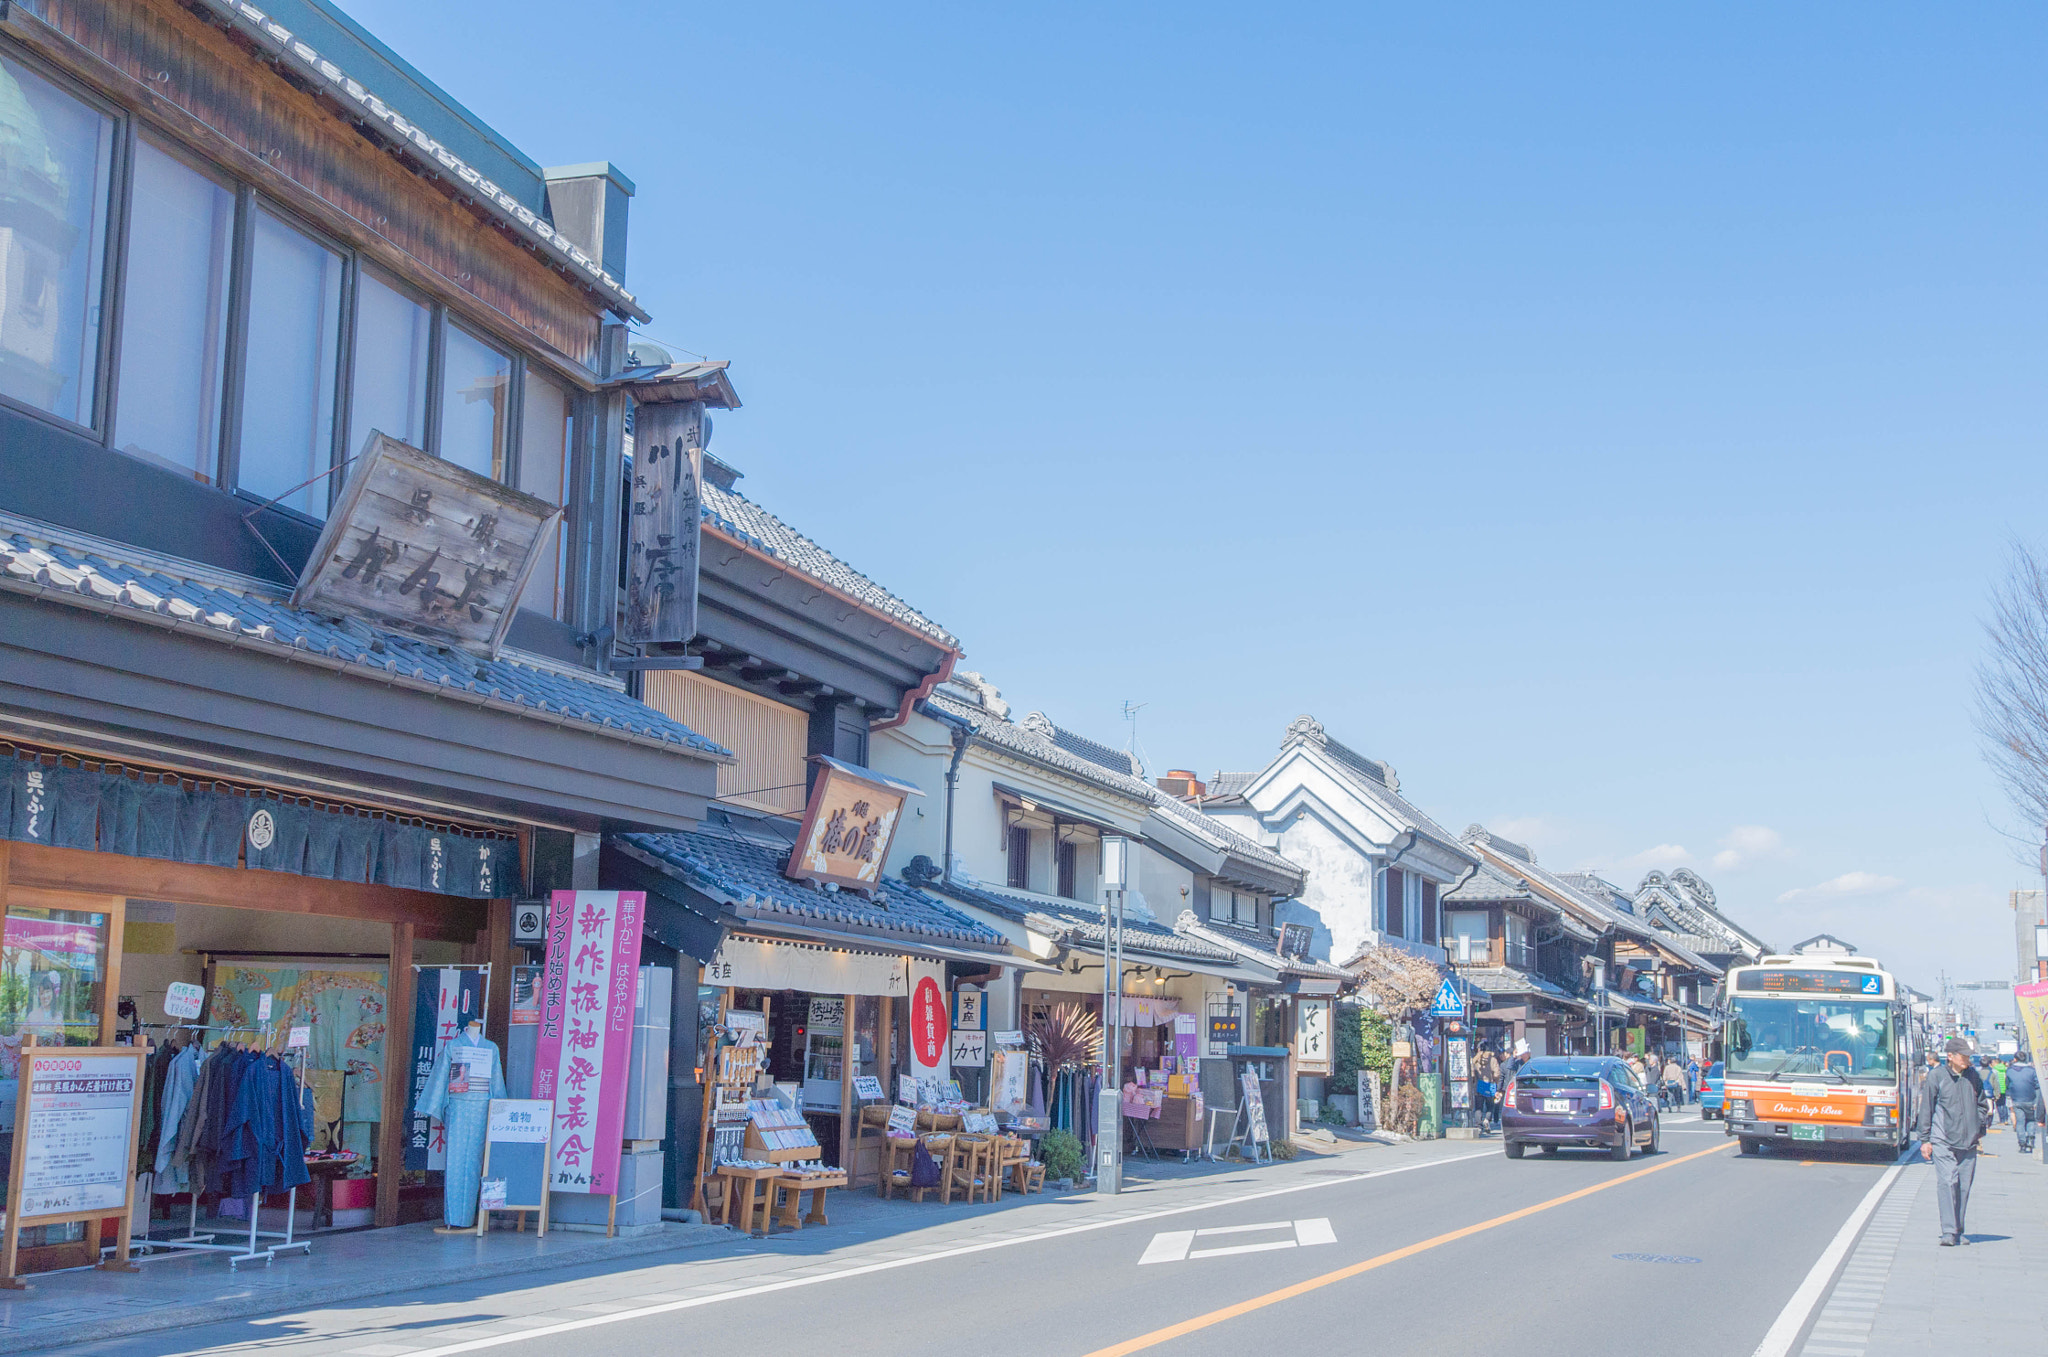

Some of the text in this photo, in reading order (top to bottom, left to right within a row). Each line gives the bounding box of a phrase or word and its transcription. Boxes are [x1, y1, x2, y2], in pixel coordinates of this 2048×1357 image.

[341, 525, 508, 624] かんだ
[26, 771, 44, 839] 呉ふく
[430, 837, 442, 889] 呉ふく
[478, 844, 492, 893] かんだ
[543, 899, 570, 1039] レンタル始めました
[611, 899, 637, 1032] 華やかに はなやかに
[962, 995, 976, 1023] 岩座
[1304, 1003, 1324, 1054] そば
[556, 903, 611, 1168] 新作振袖発表会
[954, 1042, 983, 1061] カヤ
[537, 1066, 553, 1099] 好評
[1361, 1077, 1374, 1122] 営業中
[508, 1111, 532, 1123] 着物
[1773, 1102, 1844, 1117] One-Step Bus
[557, 1170, 605, 1187] かんだ
[43, 1196, 73, 1209] かんだ
